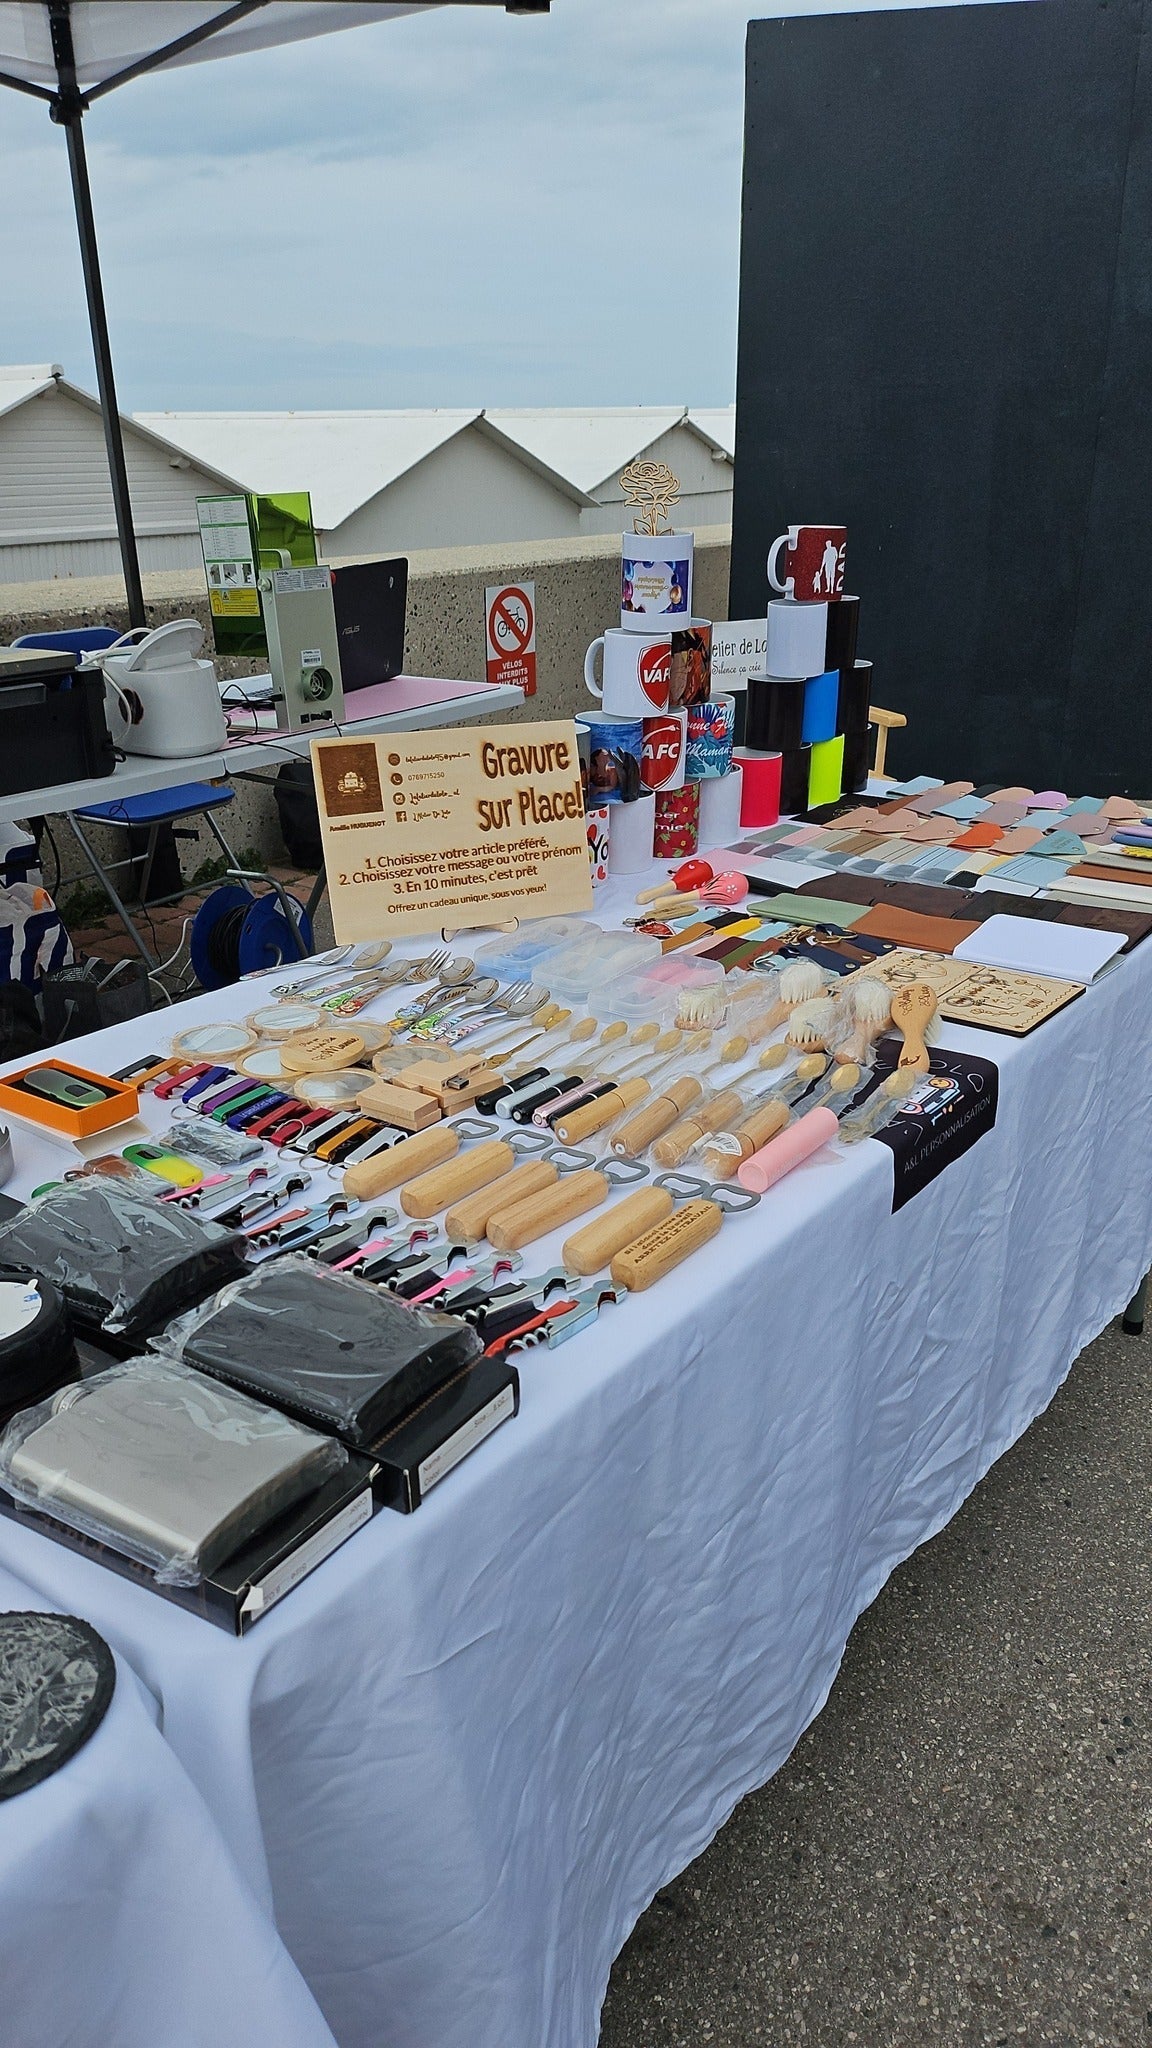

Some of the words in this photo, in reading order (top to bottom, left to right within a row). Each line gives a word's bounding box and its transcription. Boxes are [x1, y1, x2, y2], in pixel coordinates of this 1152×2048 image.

[342, 625, 365, 636] ASUS
[711, 641, 736, 658] elier
[740, 638, 752, 654] de
[754, 638, 767, 654] Lo
[496, 668, 529, 680] INTERDITS
[502, 659, 523, 670] VÉLOS
[712, 660, 736, 675] Silence
[738, 666, 746, 676] ça
[512, 676, 528, 686] PLUS
[482, 741, 570, 779] Gravure
[641, 742, 680, 760] AFC
[478, 798, 513, 832] sur
[519, 780, 586, 827] Place!
[365, 858, 376, 870] 1.
[377, 852, 438, 869] Choisissez
[440, 848, 470, 860] votre
[471, 842, 506, 858] article
[507, 838, 550, 855] préféré,
[587, 834, 609, 864] Yo
[339, 874, 351, 886] 2.
[352, 868, 414, 884] Choisissez
[415, 865, 446, 876] votre
[448, 858, 494, 873] message
[496, 856, 510, 866] ou
[510, 852, 540, 864] votre
[541, 844, 582, 861] prénom
[393, 883, 405, 894] 3.
[406, 881, 422, 893] En
[424, 878, 439, 890] 10
[440, 872, 488, 889] minutes,
[488, 870, 514, 882] c'est
[515, 865, 539, 880] prêt
[387, 902, 416, 914] Offrez
[417, 901, 429, 910] un
[429, 896, 460, 909] cadeau
[460, 892, 490, 905] unique,
[491, 890, 510, 900] sous
[510, 888, 525, 898] vos
[526, 884, 548, 896] yeux!
[904, 1155, 922, 1174] A&L
[920, 1094, 992, 1161] PERSONNALISATION
[679, 1204, 714, 1228] TRAVAIL
